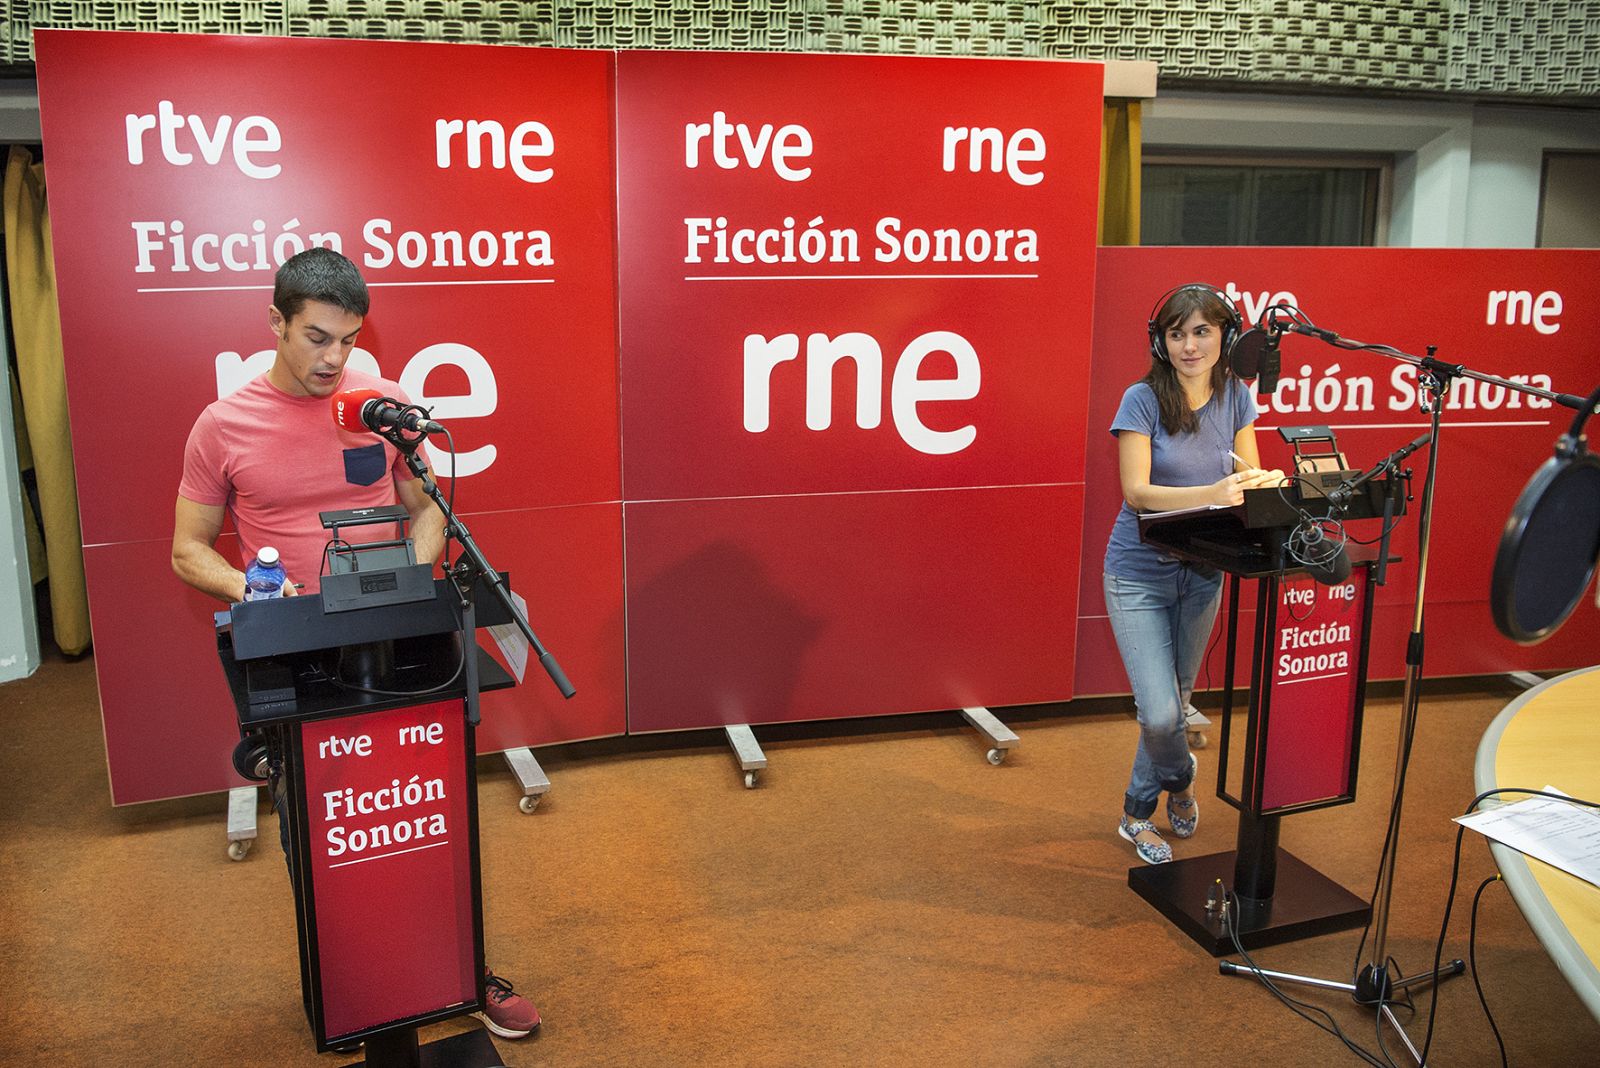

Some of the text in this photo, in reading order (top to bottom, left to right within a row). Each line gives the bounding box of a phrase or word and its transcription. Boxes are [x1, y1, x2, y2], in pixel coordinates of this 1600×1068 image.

[126, 101, 282, 180] rtve
[436, 119, 554, 183] rne
[686, 111, 812, 182] rtve
[943, 126, 1047, 186] rne
[362, 218, 554, 269] Sonora
[684, 215, 1040, 264] Ficción Sonora
[1216, 281, 1299, 335] tve
[1486, 290, 1563, 335] rne
[337, 401, 345, 426] rne
[743, 331, 982, 455] rne
[1283, 588, 1315, 605] rtve
[1328, 584, 1355, 601] rne
[1280, 621, 1351, 650] Ficción
[1278, 650, 1348, 677] Sonora
[319, 735, 372, 759] rtve
[399, 722, 444, 746] rne
[323, 775, 446, 821] Ficción
[326, 813, 448, 857] Sonora
